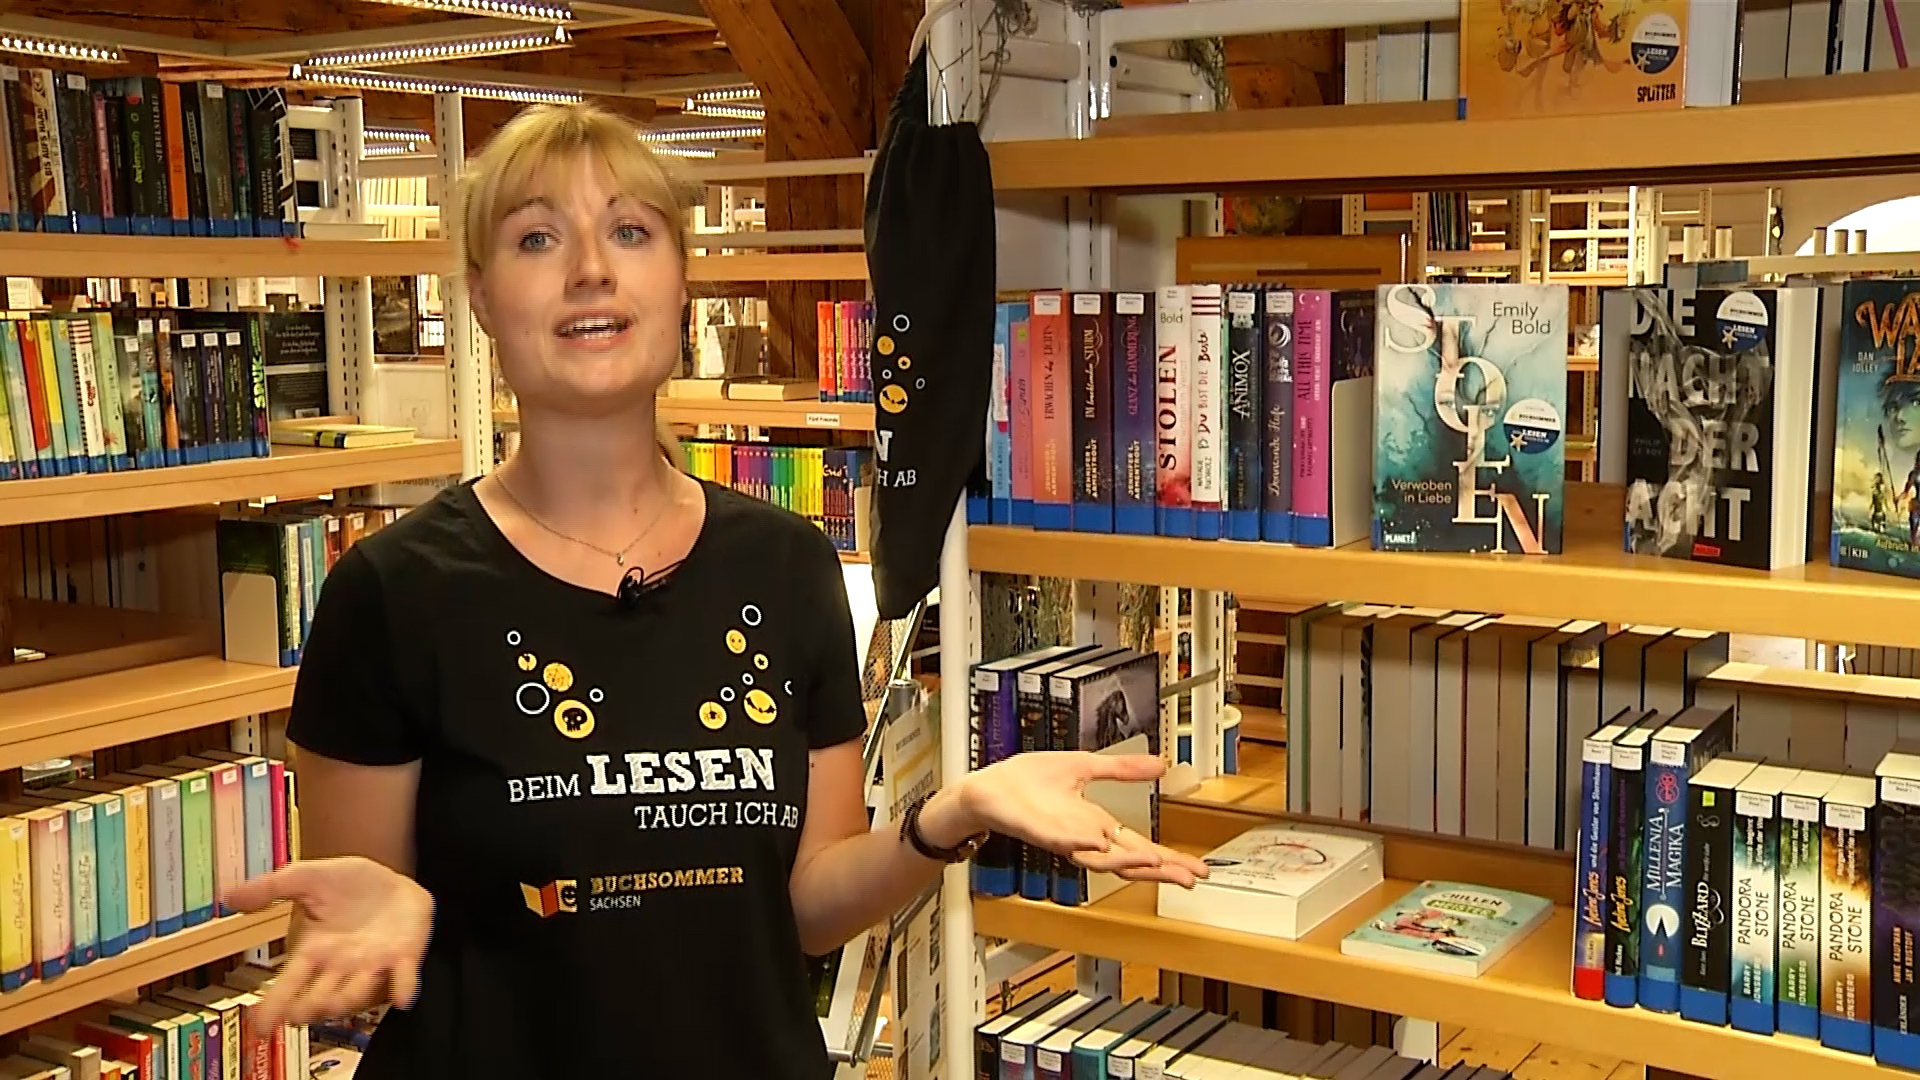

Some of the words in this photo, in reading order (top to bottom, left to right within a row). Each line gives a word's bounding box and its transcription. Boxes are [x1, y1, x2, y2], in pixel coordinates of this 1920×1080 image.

[41, 135, 49, 159] AUFS
[44, 162, 53, 177] BIS
[1159, 311, 1184, 324] Bold
[1493, 302, 1539, 321] Emily
[1630, 288, 1697, 338] DIE
[1297, 320, 1312, 345] TIME
[1511, 319, 1551, 335] Bold
[1083, 329, 1095, 361] STURM
[1857, 352, 1874, 362] DAN
[1198, 370, 1208, 385] DIE
[1297, 352, 1312, 375] THIS
[1044, 374, 1054, 420] ERWACHEN
[1198, 389, 1208, 408] BIST
[1232, 350, 1251, 420] ANIMOX
[1297, 382, 1312, 400] ALL
[1085, 406, 1095, 418] IM
[1129, 386, 1138, 415] GLANZ
[1159, 344, 1177, 471] STOLEN
[1670, 418, 1760, 473] DER
[893, 469, 917, 488] AB
[1090, 438, 1098, 498] ARMENTROUT
[1133, 440, 1141, 500] ARMENTROUT
[1392, 479, 1452, 491] Verwoben
[1404, 493, 1416, 504] in
[1416, 492, 1452, 504] Liebe
[507, 773, 581, 803] BEIM
[586, 747, 775, 795] LESEN
[1591, 763, 1602, 800] Stormhave
[634, 802, 728, 830] TAUCH
[734, 801, 778, 826] ICH
[780, 804, 799, 829] AB
[1590, 816, 1599, 841] Geister
[1590, 842, 1599, 853] die
[1590, 853, 1598, 868] und
[1647, 816, 1664, 892] MILLENIA
[1666, 823, 1684, 888] MAGIKA
[590, 866, 745, 895] BUCHSOMMER
[589, 894, 642, 912] SACHSEN
[1691, 881, 1711, 948] BLIZZARD
[1737, 877, 1752, 945] PANDORA
[1754, 891, 1769, 938] STONE
[1782, 881, 1797, 950] PANDORA
[1799, 895, 1815, 942] STONE
[1829, 892, 1844, 962] PANDORA
[1847, 906, 1863, 954] STONE
[1893, 926, 1902, 963] KAUFMAN
[1905, 931, 1914, 967] KRISTOFF
[1743, 964, 1751, 995] BARRY
[1788, 967, 1796, 998] BARRY
[1893, 963, 1902, 984] AMIE
[1905, 968, 1914, 984] JAY
[1836, 980, 1844, 1012] BARRY
